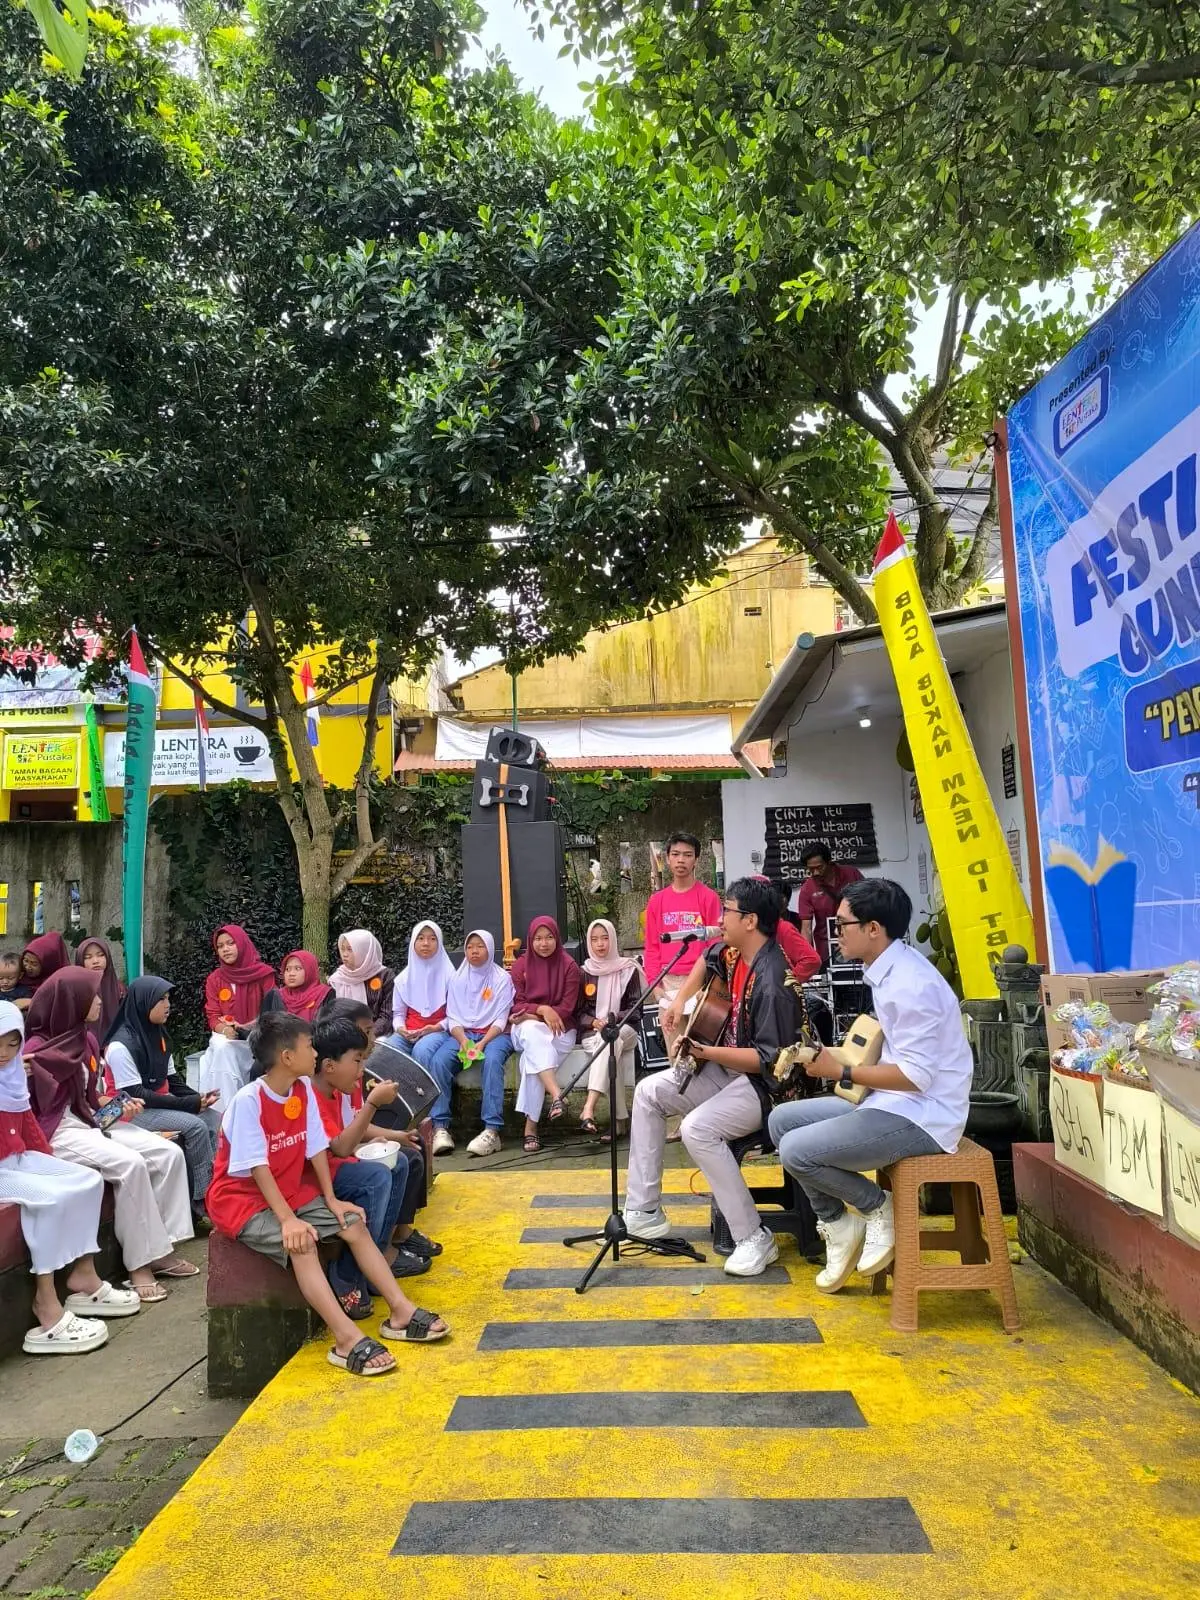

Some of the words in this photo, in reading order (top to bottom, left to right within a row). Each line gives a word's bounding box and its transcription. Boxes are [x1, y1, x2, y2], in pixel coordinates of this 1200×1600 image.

[1049, 357, 1098, 412] Presented
[38, 753, 73, 761] Pustaka
[161, 737, 228, 752] LENTRA
[1103, 1109, 1155, 1190] TBM
[1168, 1131, 1200, 1208] LEN
